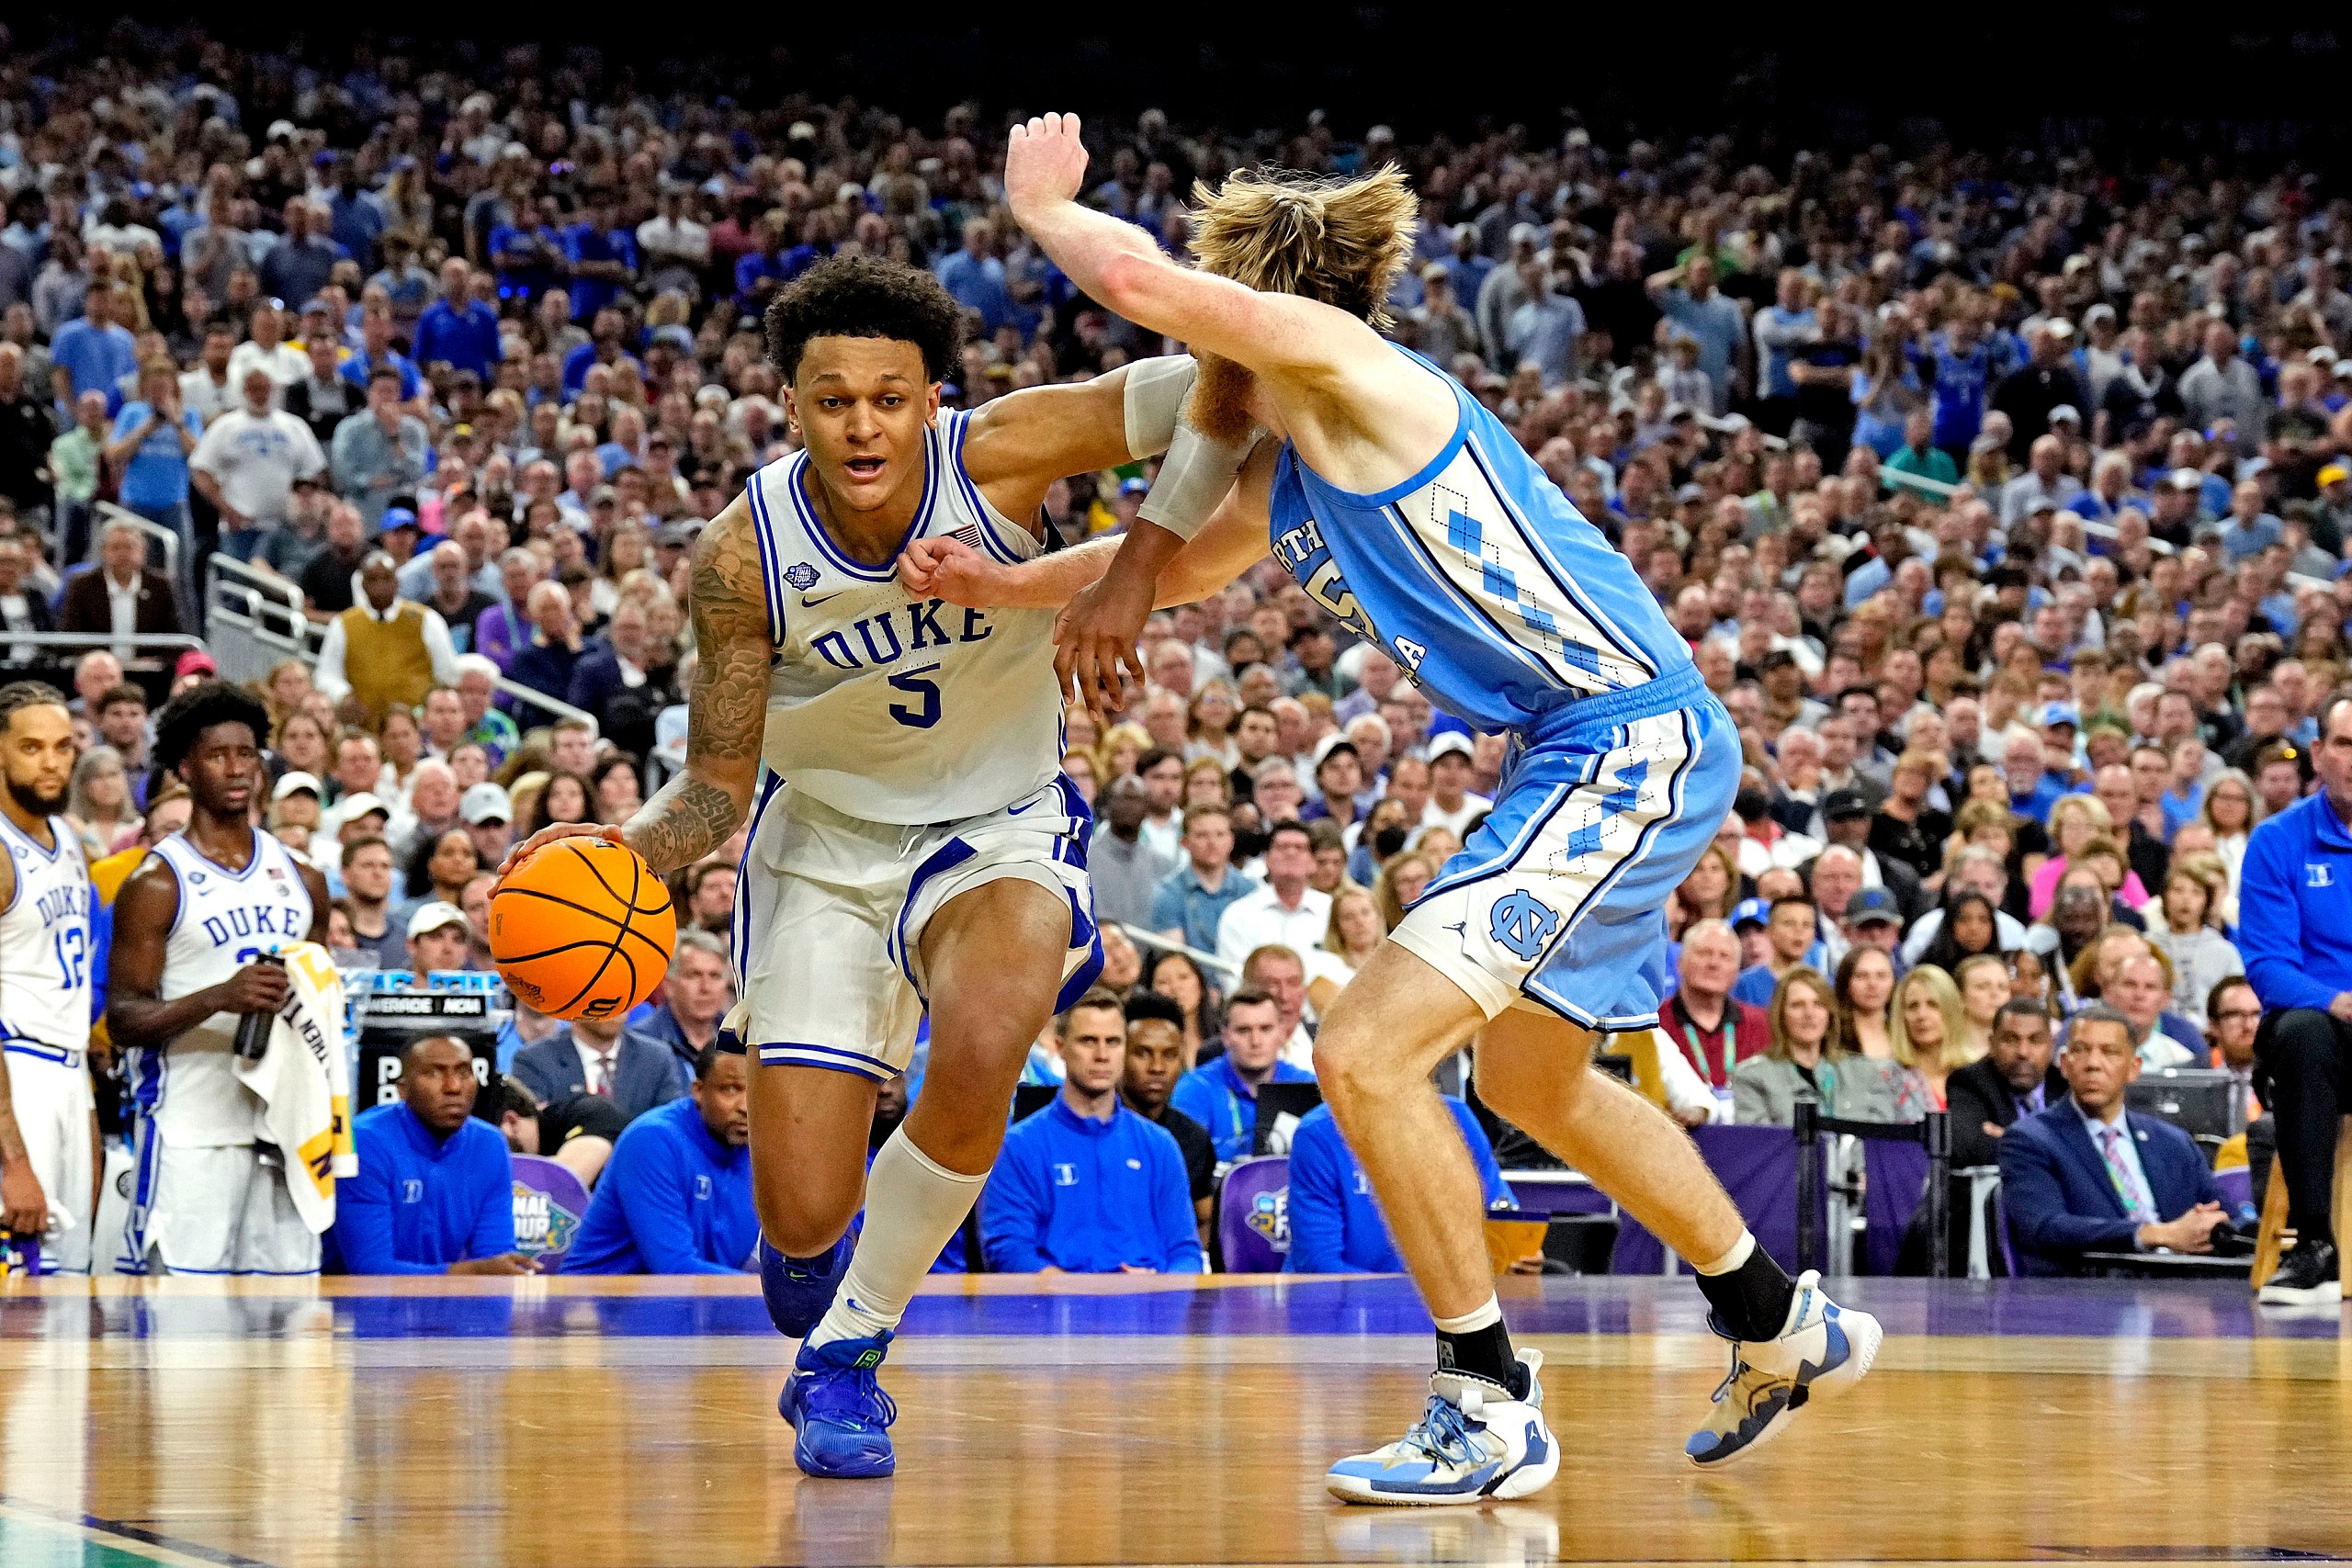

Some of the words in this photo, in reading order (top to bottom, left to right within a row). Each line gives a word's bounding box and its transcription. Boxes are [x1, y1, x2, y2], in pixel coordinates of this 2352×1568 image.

[810, 599, 994, 670] DUKE
[888, 661, 943, 729] 5
[202, 904, 301, 948] DUKE
[56, 928, 85, 989] 12
